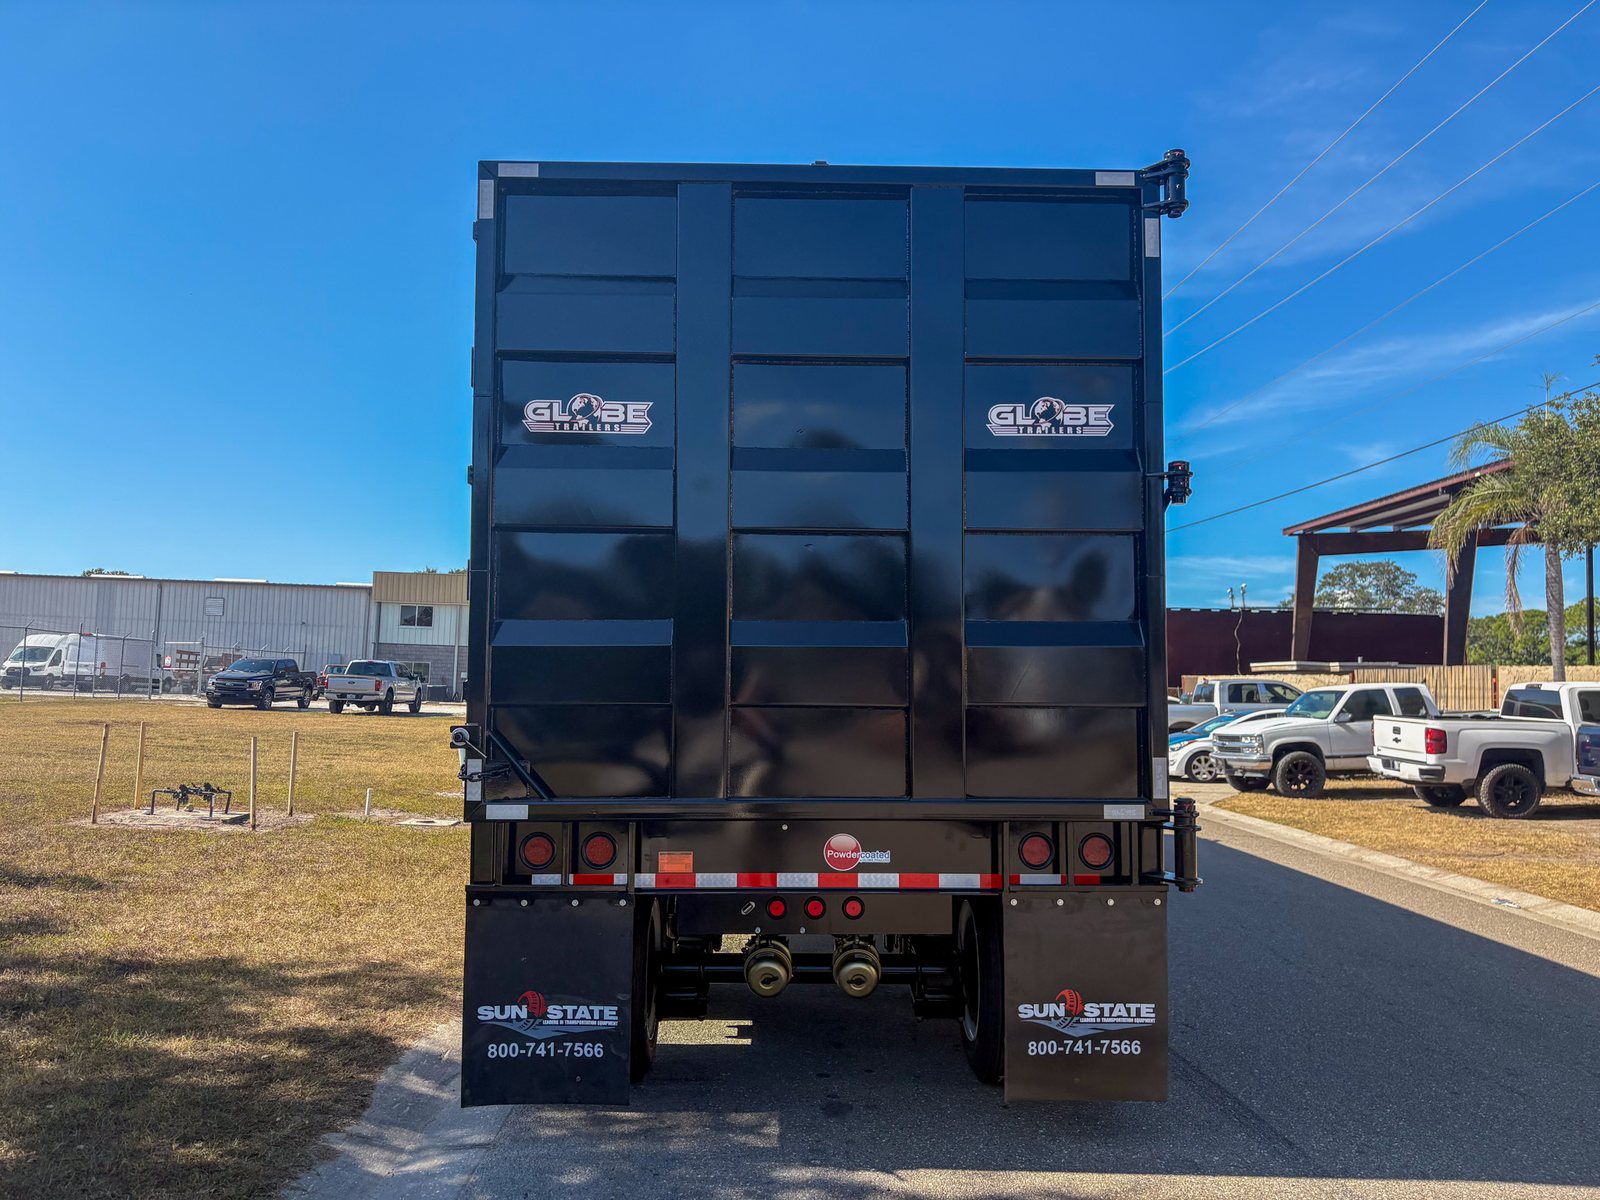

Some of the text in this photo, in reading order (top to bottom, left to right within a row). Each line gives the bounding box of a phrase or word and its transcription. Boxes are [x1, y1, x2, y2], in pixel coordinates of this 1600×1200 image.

[525, 394, 652, 422] GLOBE
[989, 398, 1113, 426] GLOBE
[554, 422, 621, 432] TRAILERS
[1018, 426, 1083, 434] TRAILERS
[477, 1005, 619, 1021] SUN STATE
[1017, 1003, 1156, 1019] SUN STATE
[487, 1042, 604, 1059] 800-741-7566
[1027, 1040, 1142, 1056] 800-741-7566
